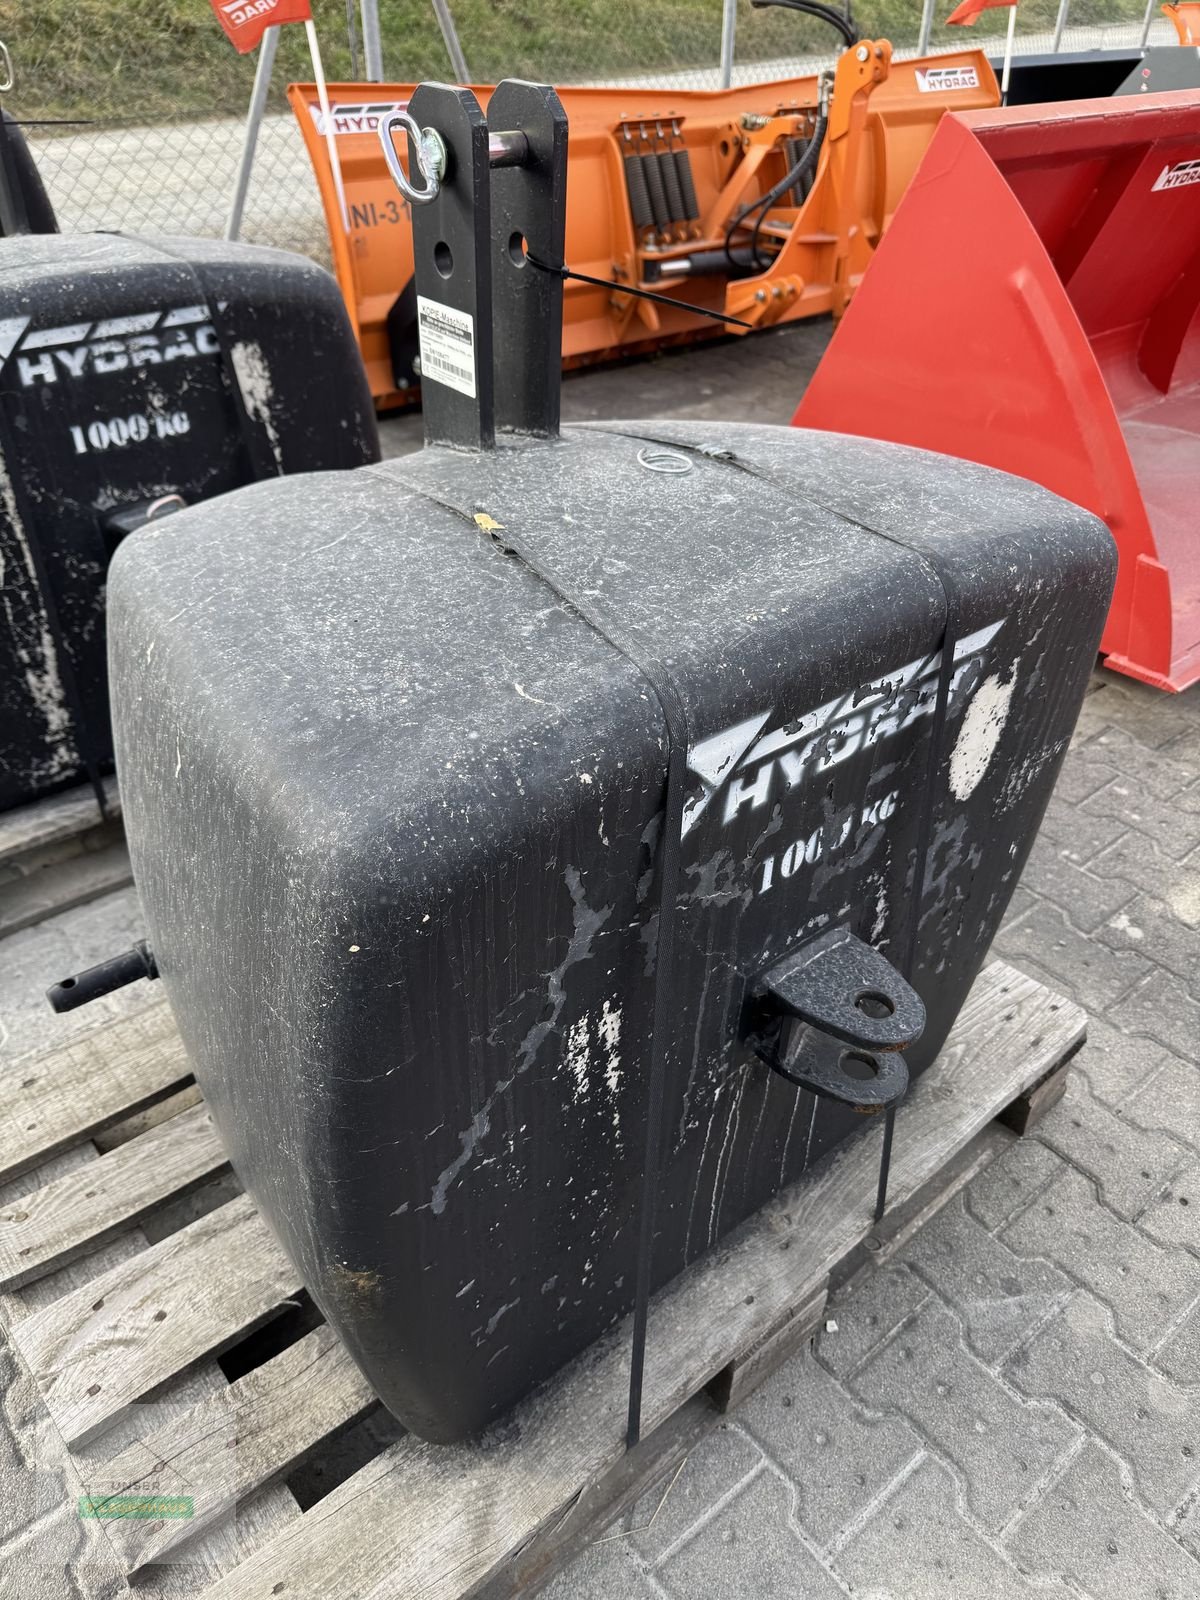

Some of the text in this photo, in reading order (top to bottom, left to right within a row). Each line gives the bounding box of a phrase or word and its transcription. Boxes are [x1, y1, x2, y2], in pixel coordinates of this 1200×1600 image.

[927, 76, 976, 89] HYDRAC
[334, 116, 382, 131] HYD
[347, 201, 412, 229] NI-31
[17, 325, 221, 387] HYDRAC
[69, 413, 150, 454] 1000
